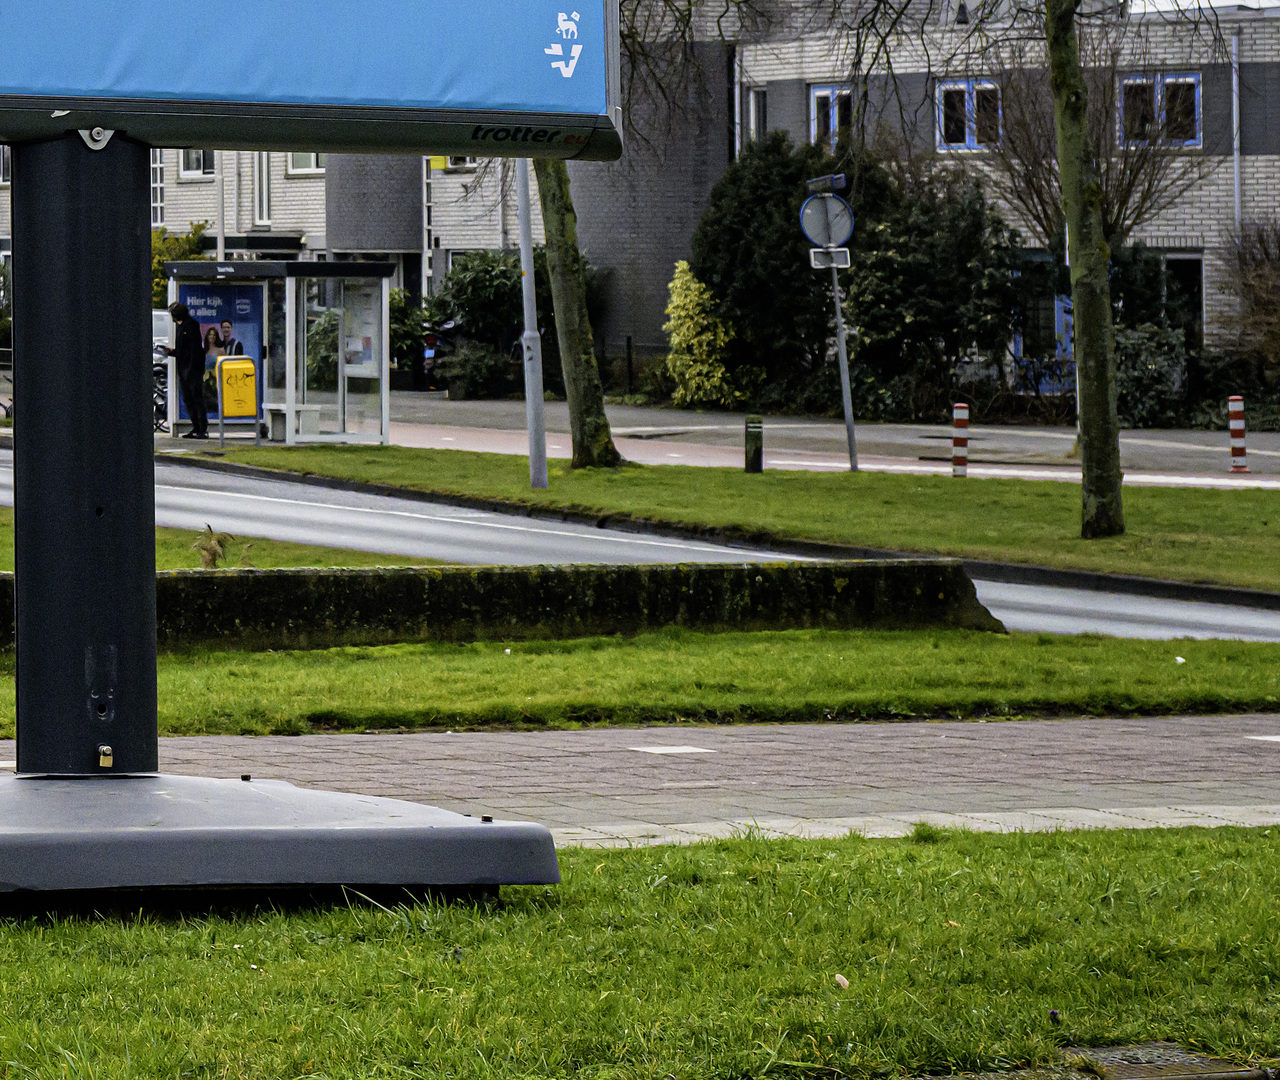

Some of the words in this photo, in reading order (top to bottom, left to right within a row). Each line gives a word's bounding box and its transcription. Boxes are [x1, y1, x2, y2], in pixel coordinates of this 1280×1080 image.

[187, 296, 206, 306] Hier
[207, 296, 223, 307] kijk
[196, 307, 217, 316] alles
